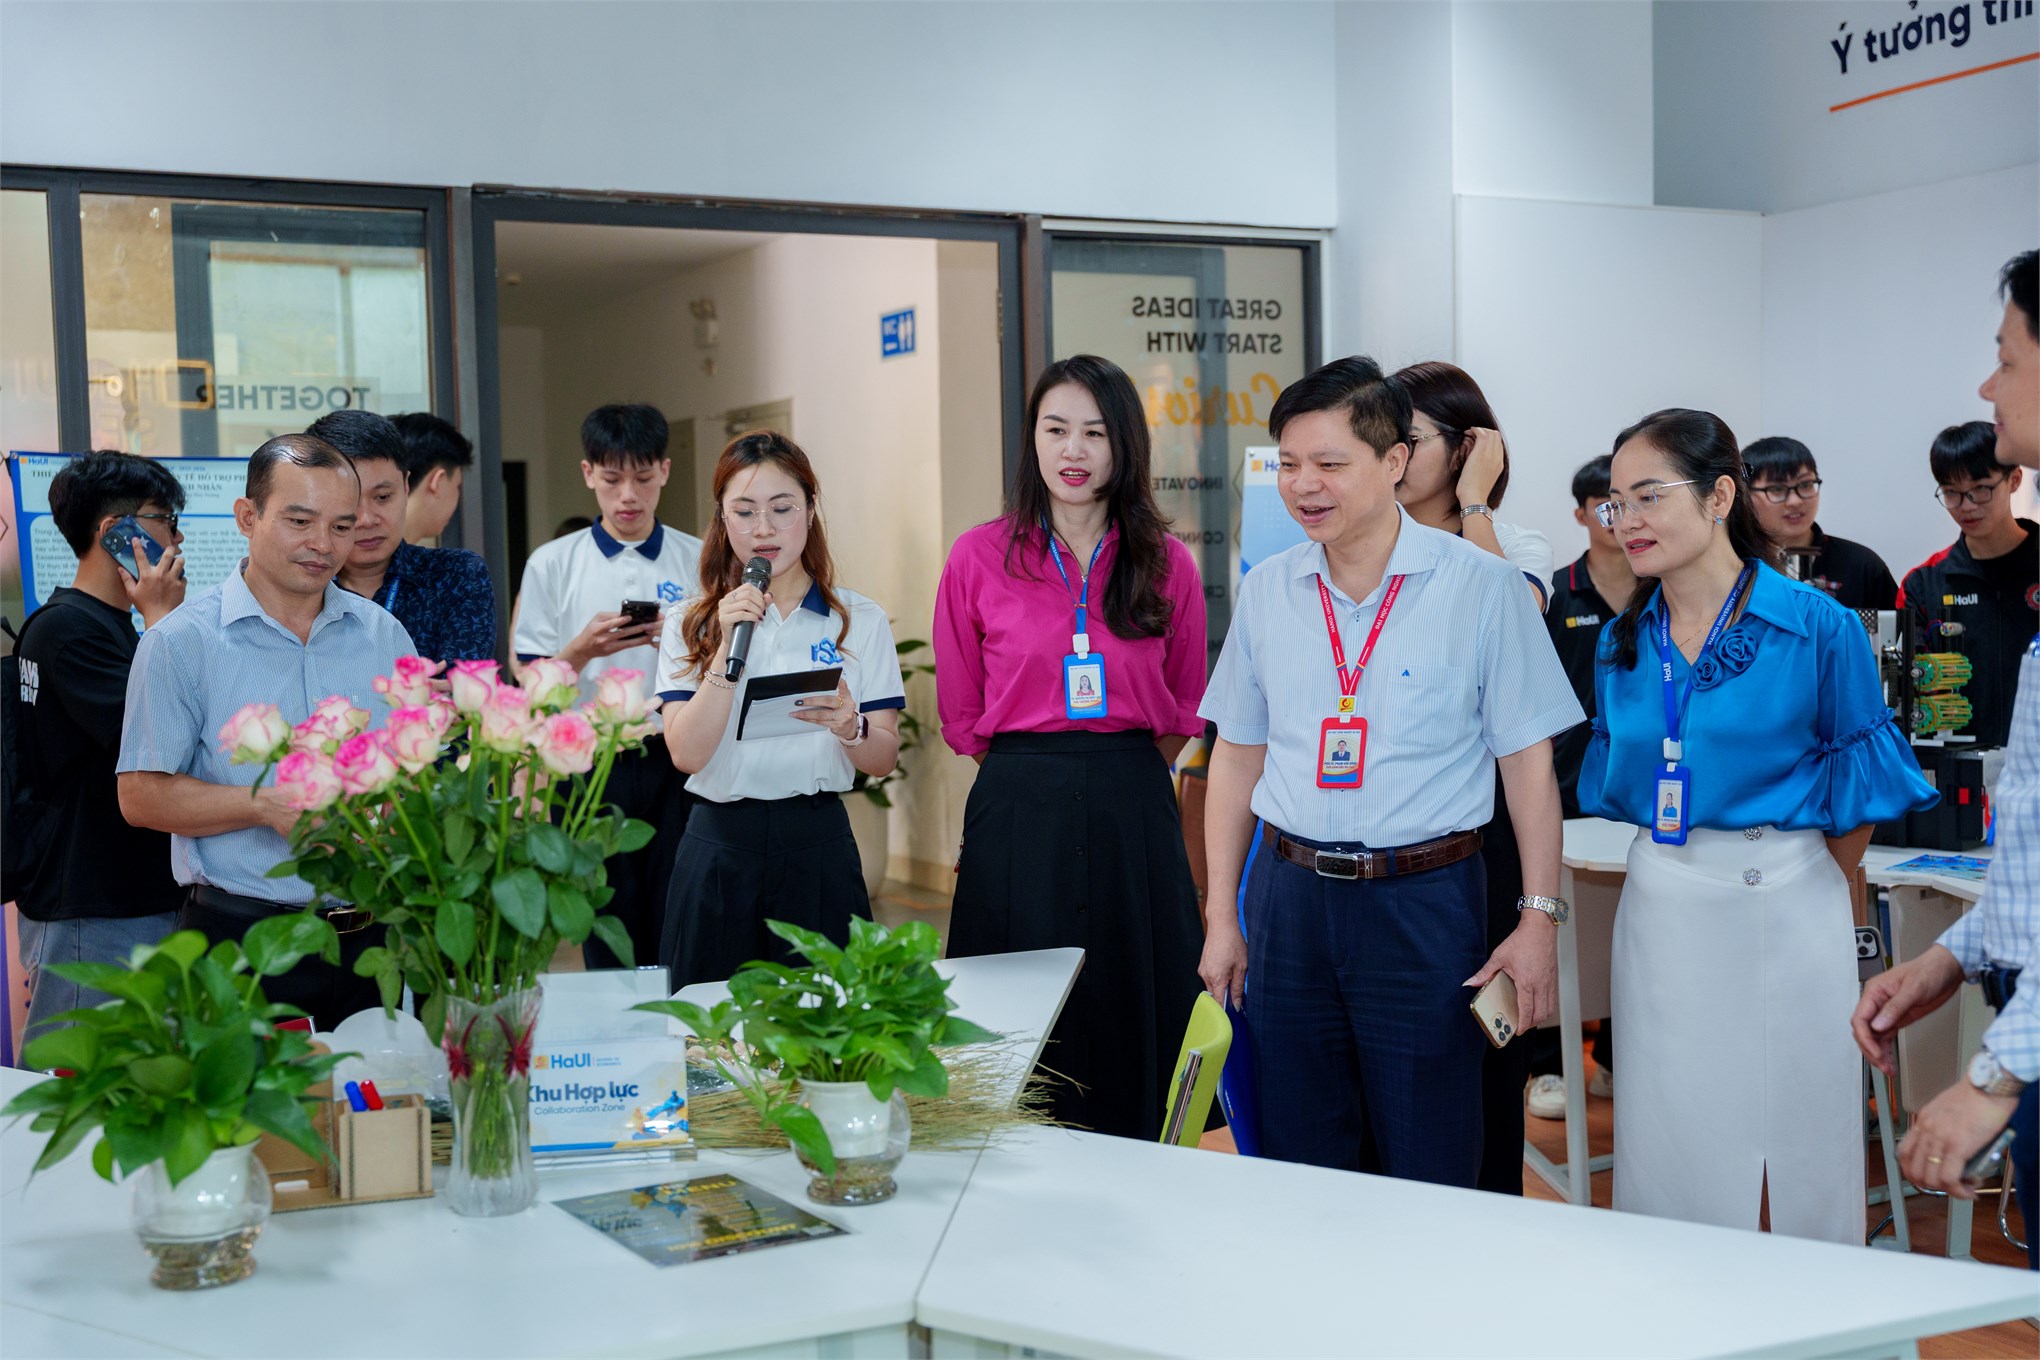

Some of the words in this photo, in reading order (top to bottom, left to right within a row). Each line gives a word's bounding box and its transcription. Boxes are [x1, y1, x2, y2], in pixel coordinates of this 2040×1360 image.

[1831, 22, 1853, 74] Ý
[1864, 0, 1970, 63] tưởng
[1954, 593, 1979, 605] HaUI
[1576, 614, 1600, 627] HaUI
[1707, 626, 1720, 645] HANOI
[1716, 598, 1736, 627] UNIVERSITY
[1663, 662, 1672, 682] HaUI
[551, 1053, 591, 1069] HaUI
[565, 1082, 606, 1104] Hợp
[609, 1081, 639, 1102] lực
[534, 1104, 600, 1116] Collaboration
[602, 1103, 626, 1112] Zone
